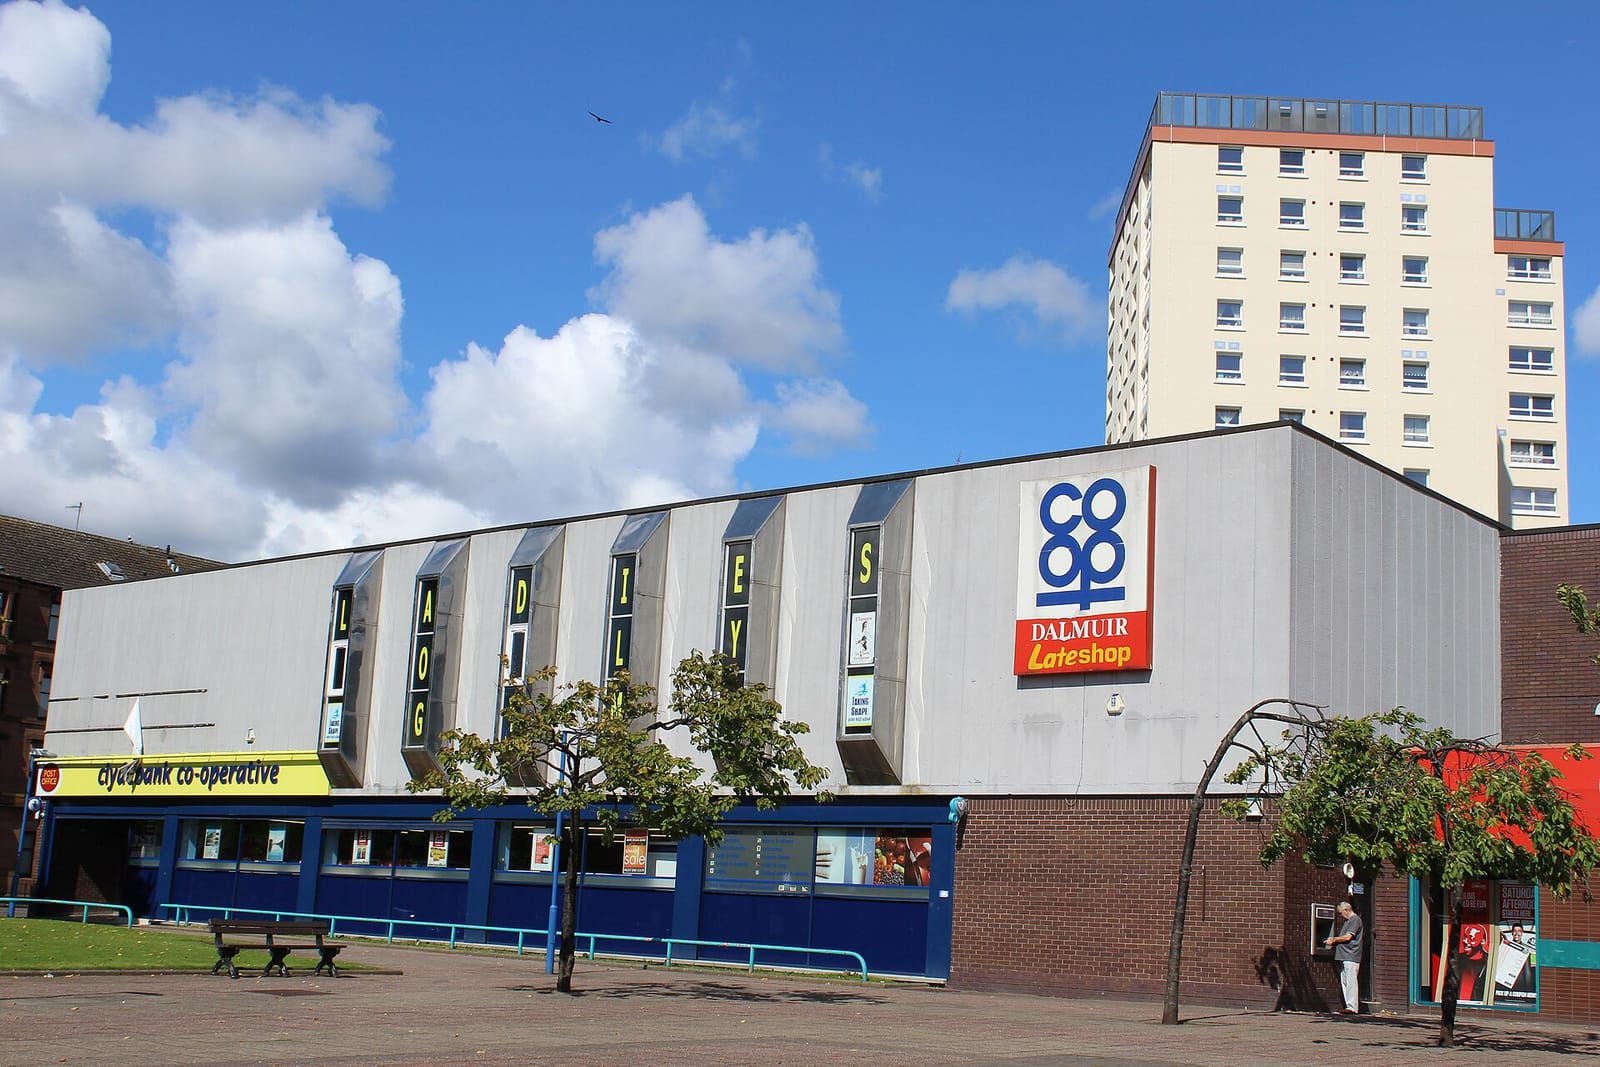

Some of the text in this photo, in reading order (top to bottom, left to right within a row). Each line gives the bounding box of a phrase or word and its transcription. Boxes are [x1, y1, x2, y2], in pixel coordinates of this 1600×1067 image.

[1031, 617, 1128, 642] DALMUIR
[1027, 642, 1131, 671] Lateshop
[43, 769, 57, 778] POST
[97, 759, 280, 791] clydbank co-operative
[624, 846, 645, 865] sale
